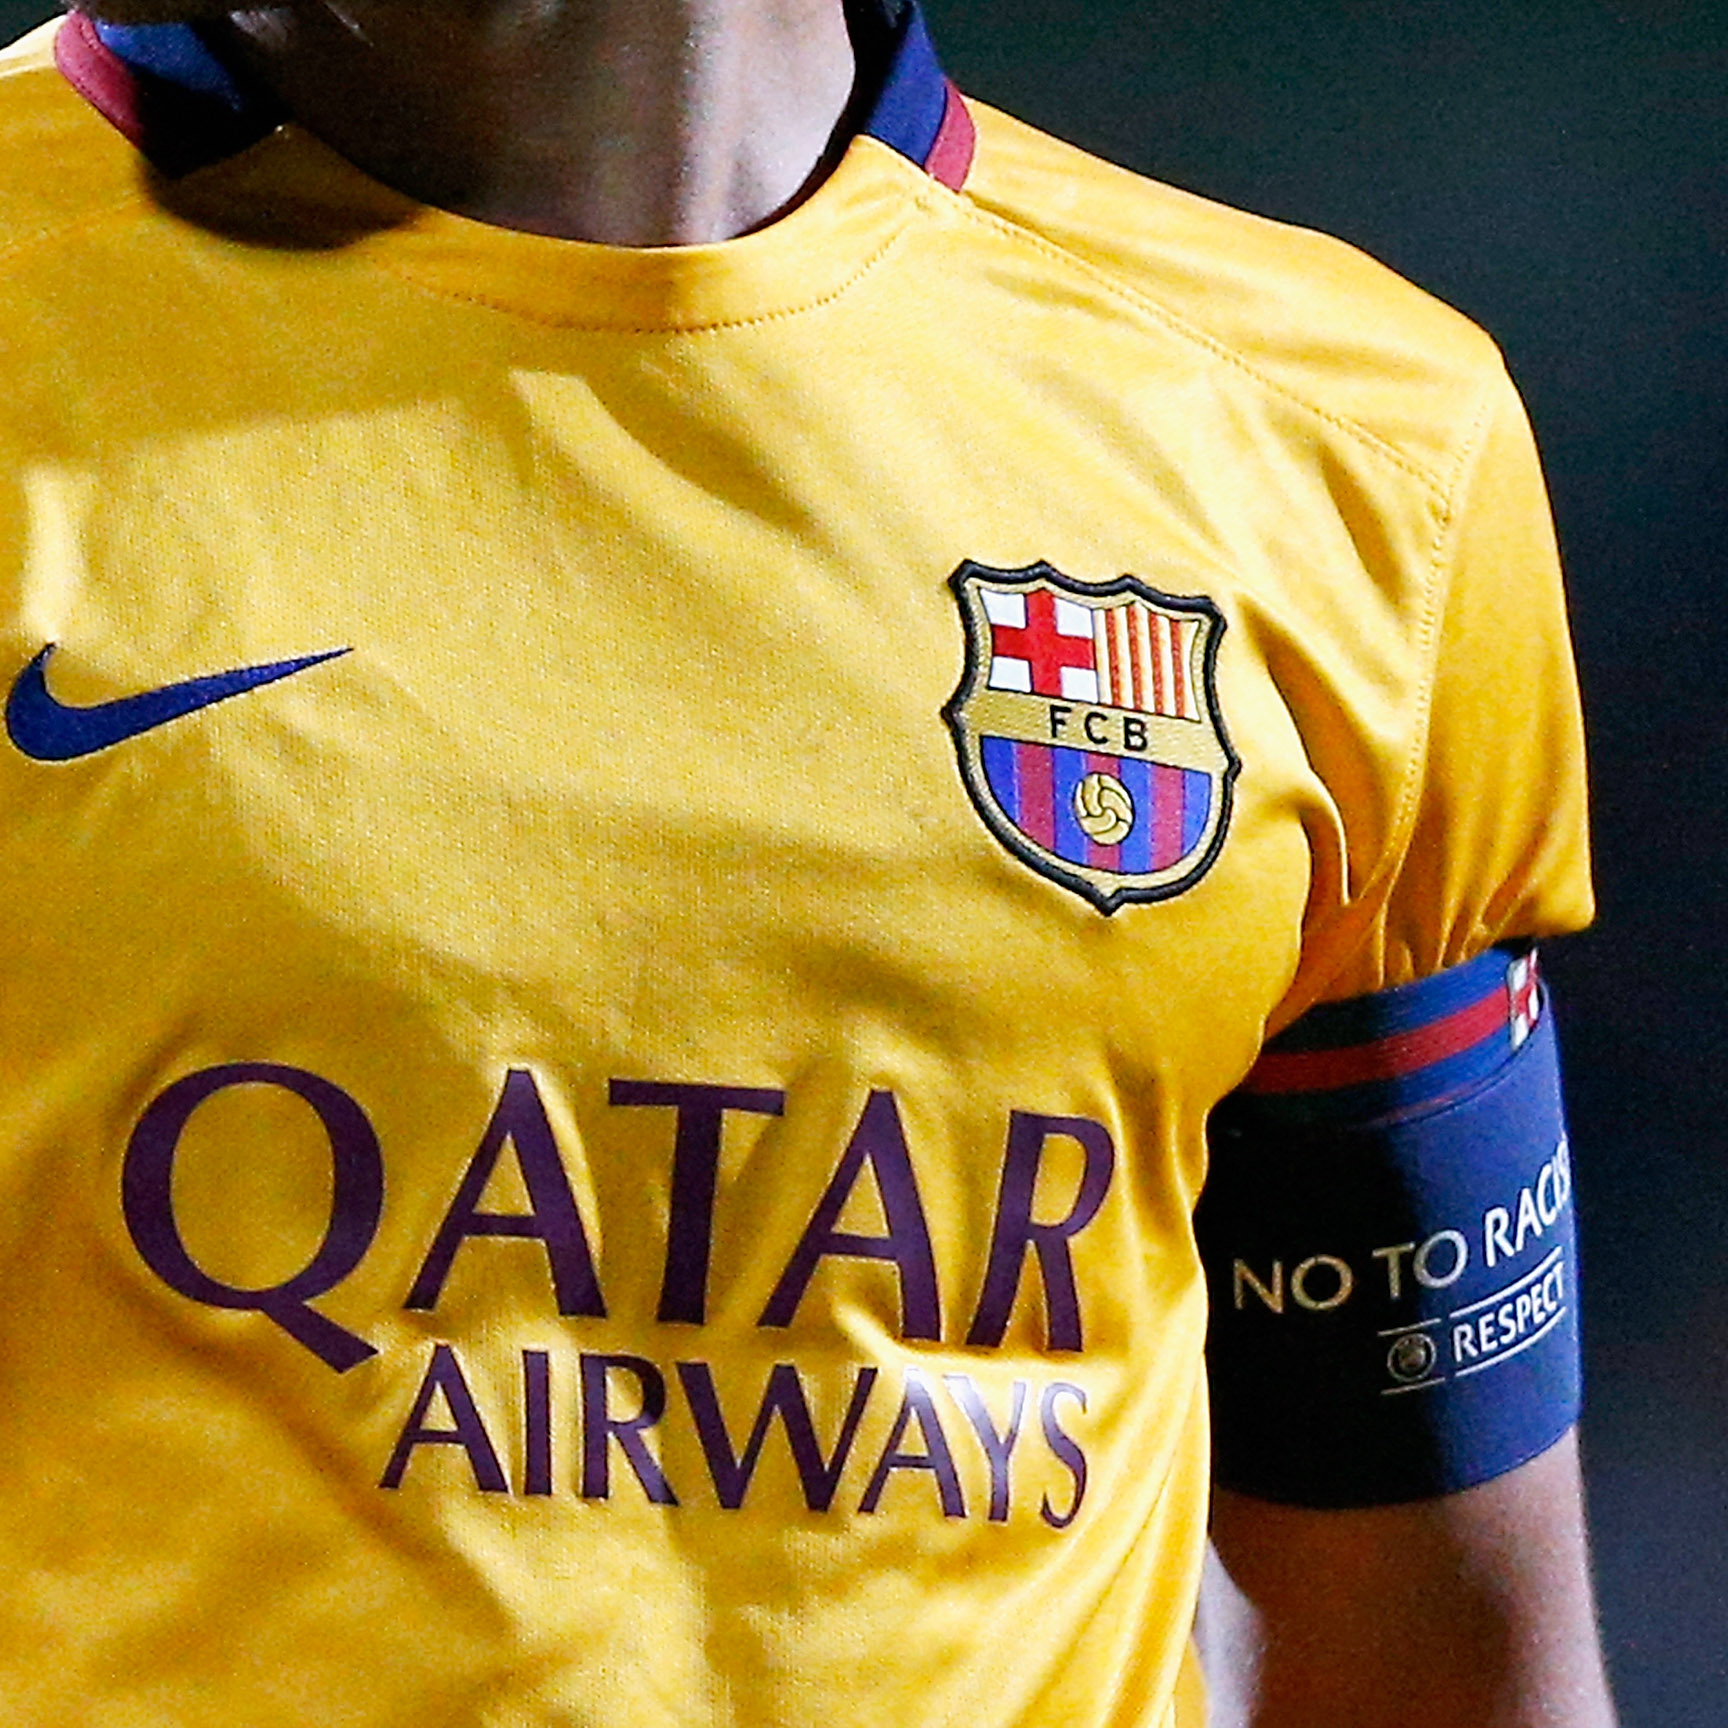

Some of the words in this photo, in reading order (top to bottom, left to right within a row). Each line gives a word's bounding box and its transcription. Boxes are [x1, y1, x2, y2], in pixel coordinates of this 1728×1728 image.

[1048, 704, 1149, 752] FCB
[120, 1061, 1115, 1374] QATAR
[1232, 1255, 1354, 1314] NO
[1372, 1229, 1468, 1300] TO
[1452, 1260, 1566, 1363] RESPECT
[379, 1343, 1088, 1530] AIRWAYS
